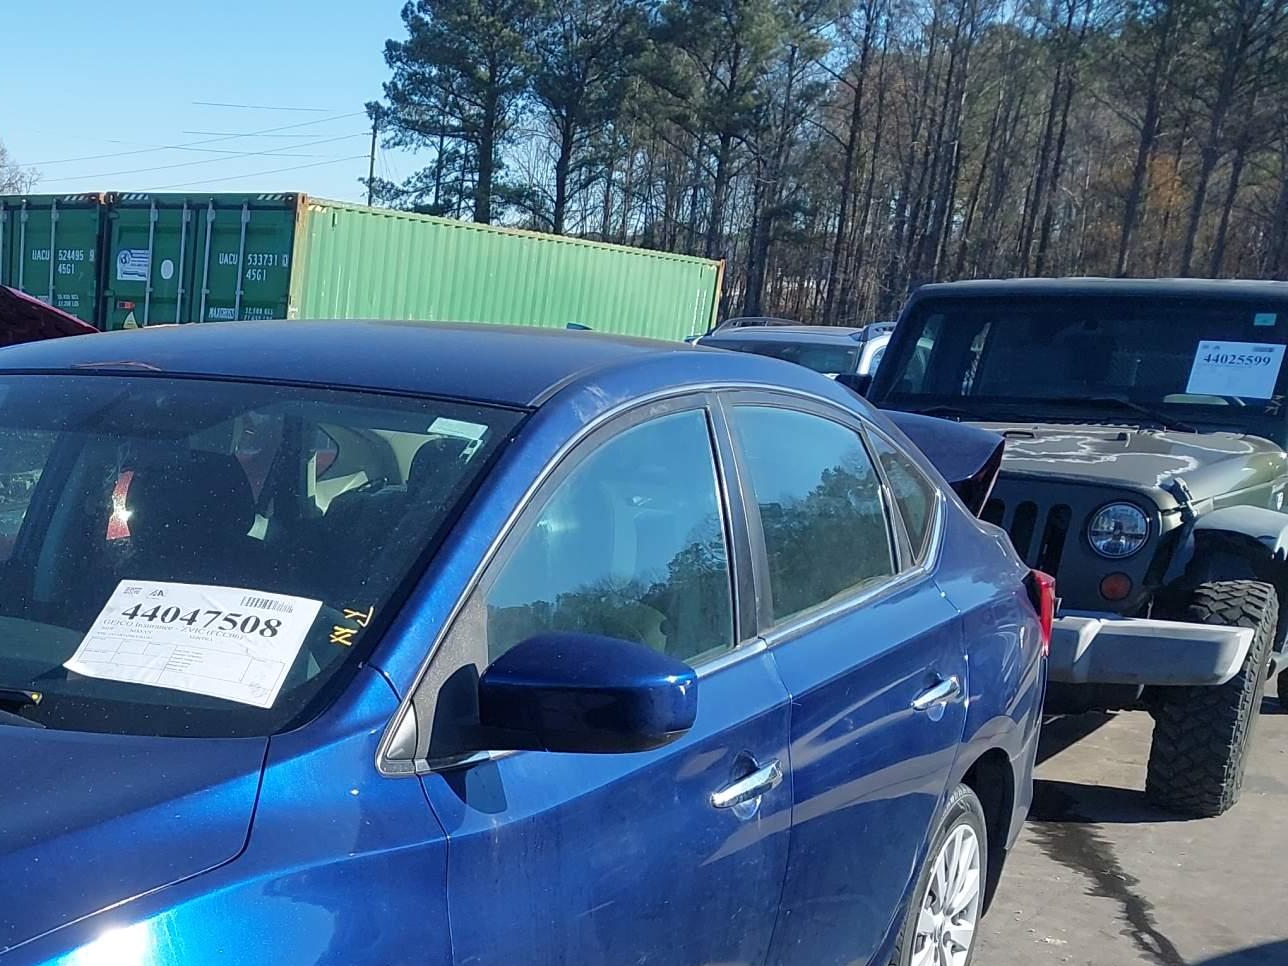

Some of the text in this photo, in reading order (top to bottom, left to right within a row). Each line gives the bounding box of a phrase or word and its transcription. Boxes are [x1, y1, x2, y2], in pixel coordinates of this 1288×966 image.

[32, 249, 50, 260] UACU
[58, 249, 84, 261] 524495
[219, 253, 238, 265] UACU
[247, 253, 278, 266] 533731
[246, 269, 266, 281] 45G1
[1204, 353, 1271, 366] 44025599
[103, 619, 133, 628] GEICO
[135, 621, 174, 631] Insurance
[121, 603, 282, 638] 44047508
